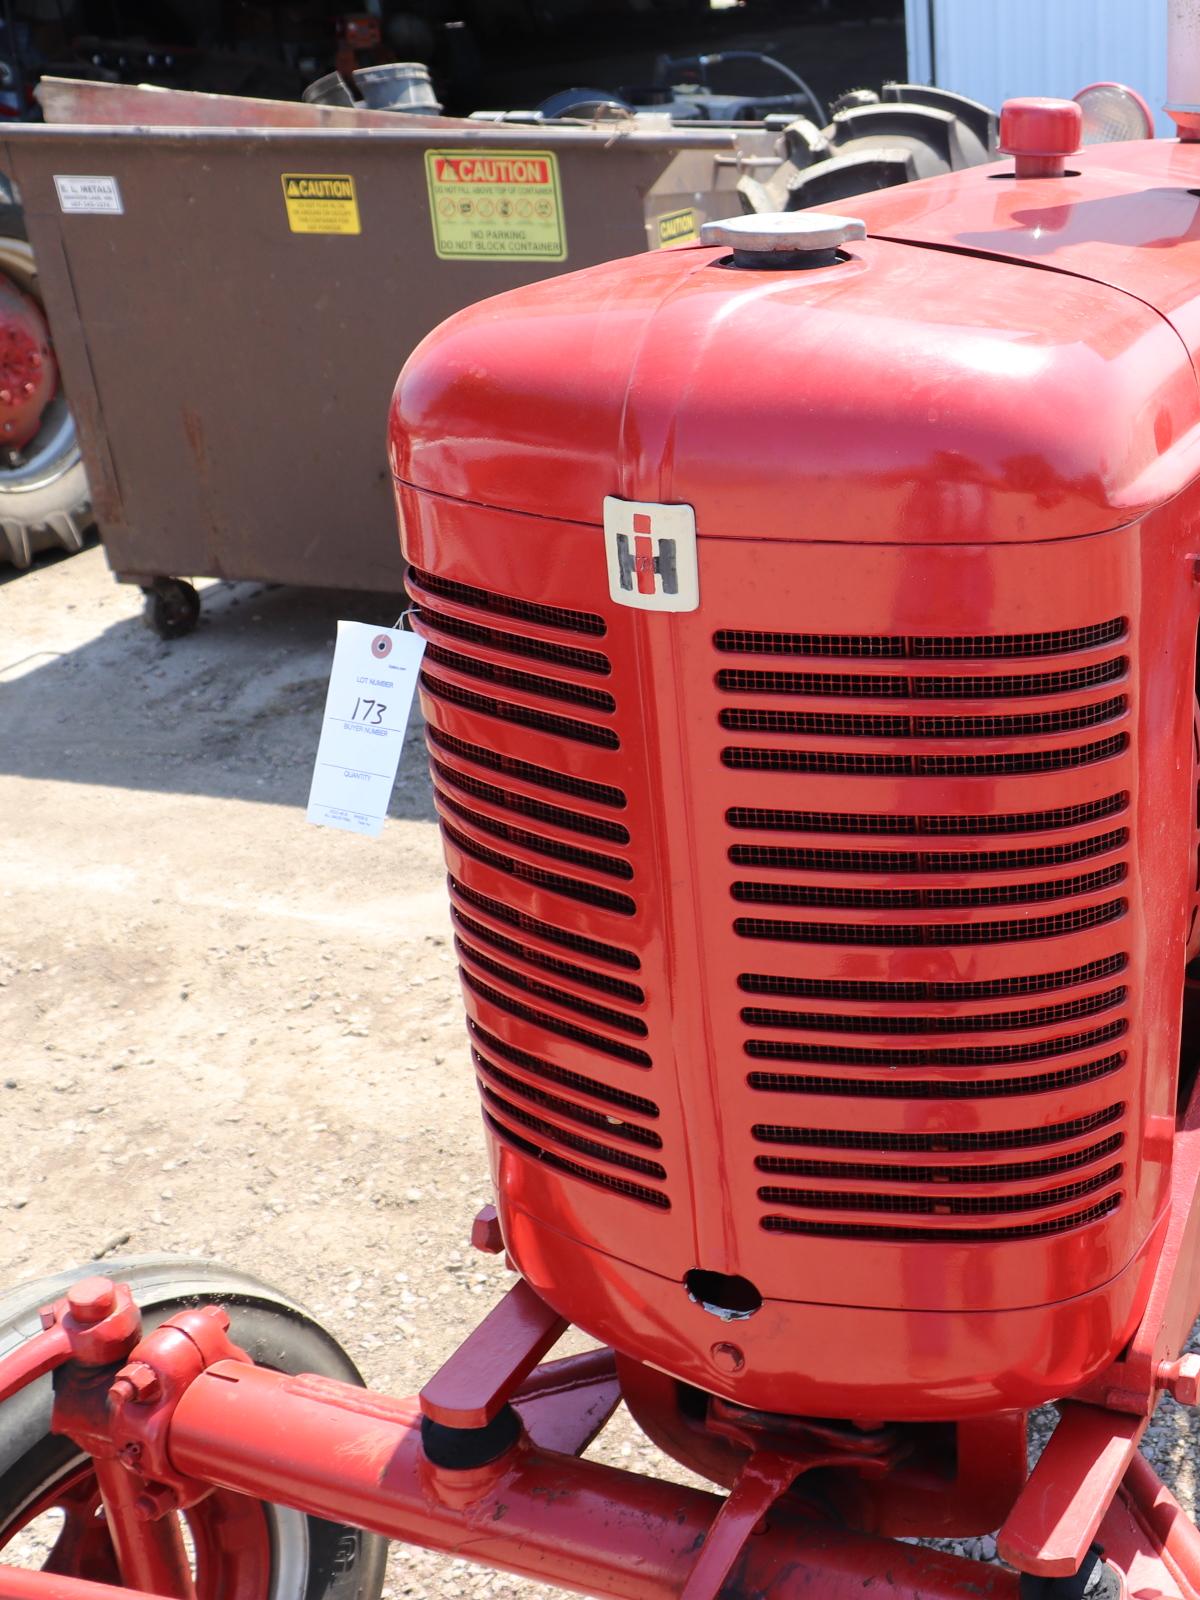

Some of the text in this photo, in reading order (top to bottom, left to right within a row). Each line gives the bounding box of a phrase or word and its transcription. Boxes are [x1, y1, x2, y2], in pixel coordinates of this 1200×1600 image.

[459, 160, 541, 181] CAUTION
[299, 180, 352, 197] CAUTION
[660, 215, 693, 240] CAUTION
[471, 230, 526, 240] NO PARKING
[440, 240, 560, 252] DO NOT BLOCK CONTAINER
[356, 676, 394, 689] LOT NUMBER
[351, 697, 387, 725] 173
[344, 723, 388, 737] BUYER NUMBER
[344, 770, 371, 782] QUANTITY
